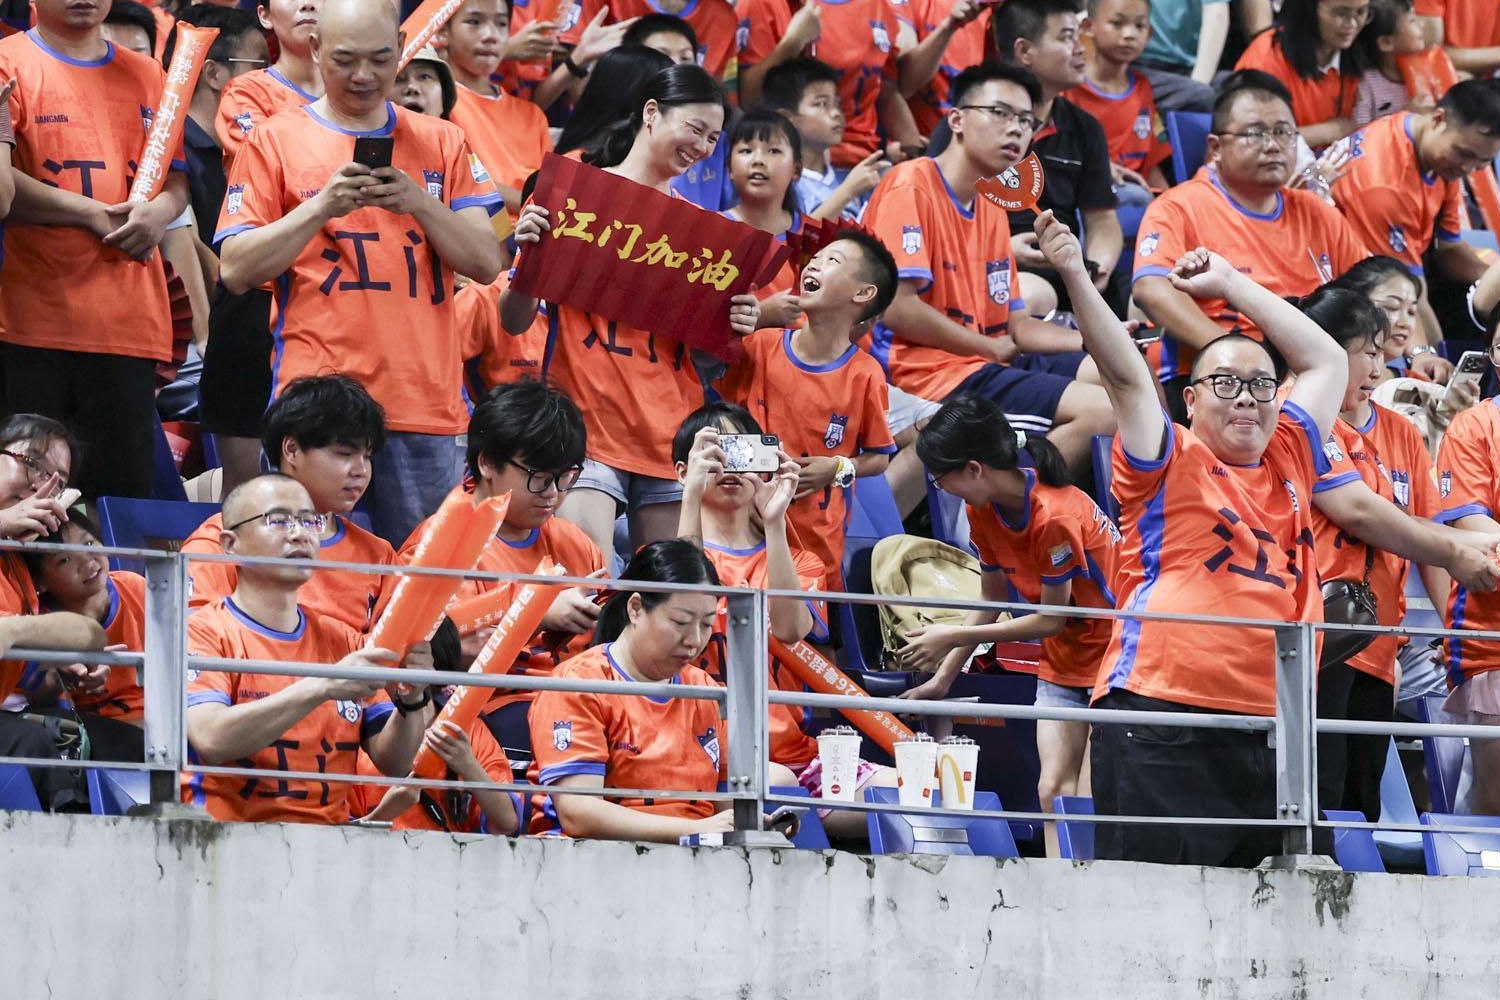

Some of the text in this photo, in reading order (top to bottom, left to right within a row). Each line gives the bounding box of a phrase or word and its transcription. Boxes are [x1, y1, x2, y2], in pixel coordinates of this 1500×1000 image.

[319, 230, 446, 305] 江门
[552, 198, 740, 291] 江门加油
